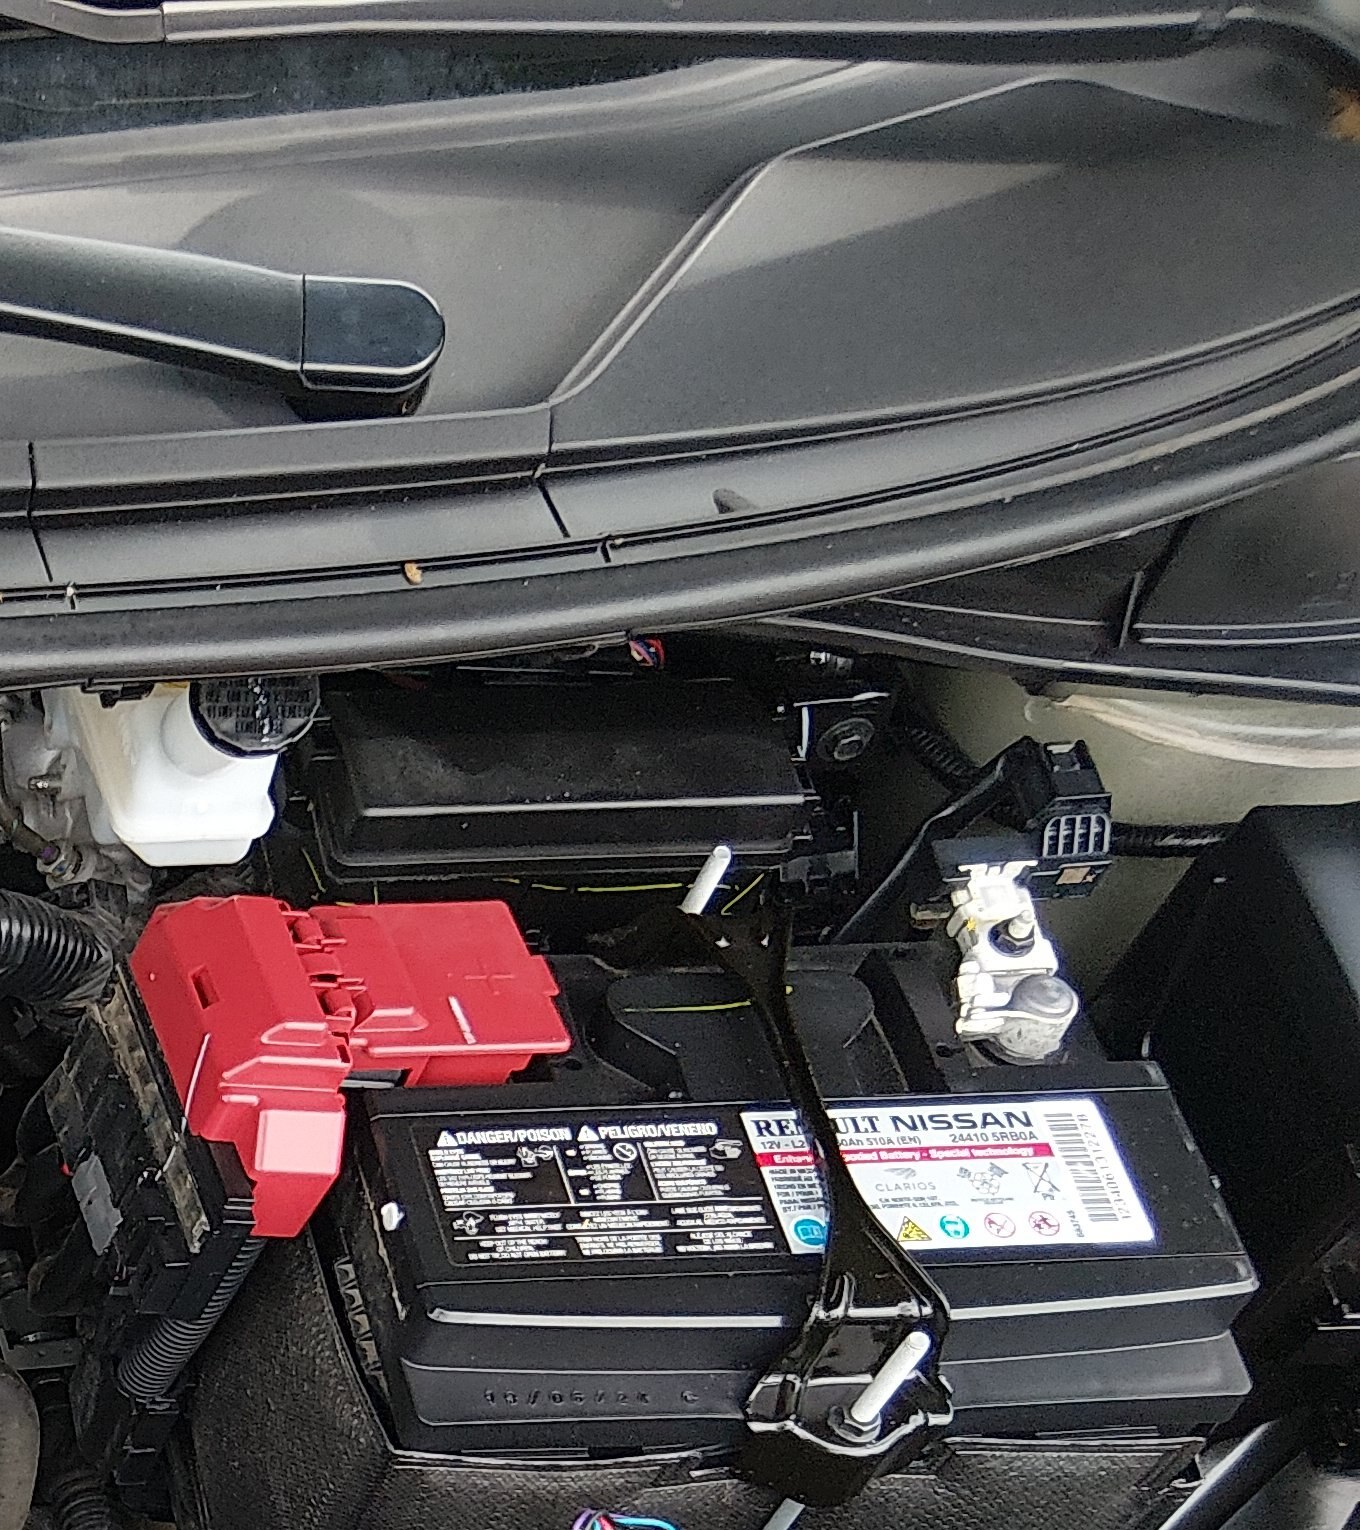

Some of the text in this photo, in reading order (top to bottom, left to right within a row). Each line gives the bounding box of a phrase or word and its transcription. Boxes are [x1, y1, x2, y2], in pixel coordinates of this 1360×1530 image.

[597, 1122, 718, 1139] PELIGRO/VENENO
[750, 1111, 1034, 1137] REULT NISSAN
[456, 1127, 573, 1145] DANGER/POISON
[949, 1132, 990, 1144] 24410
[875, 1183, 937, 1192] CLARIOS
